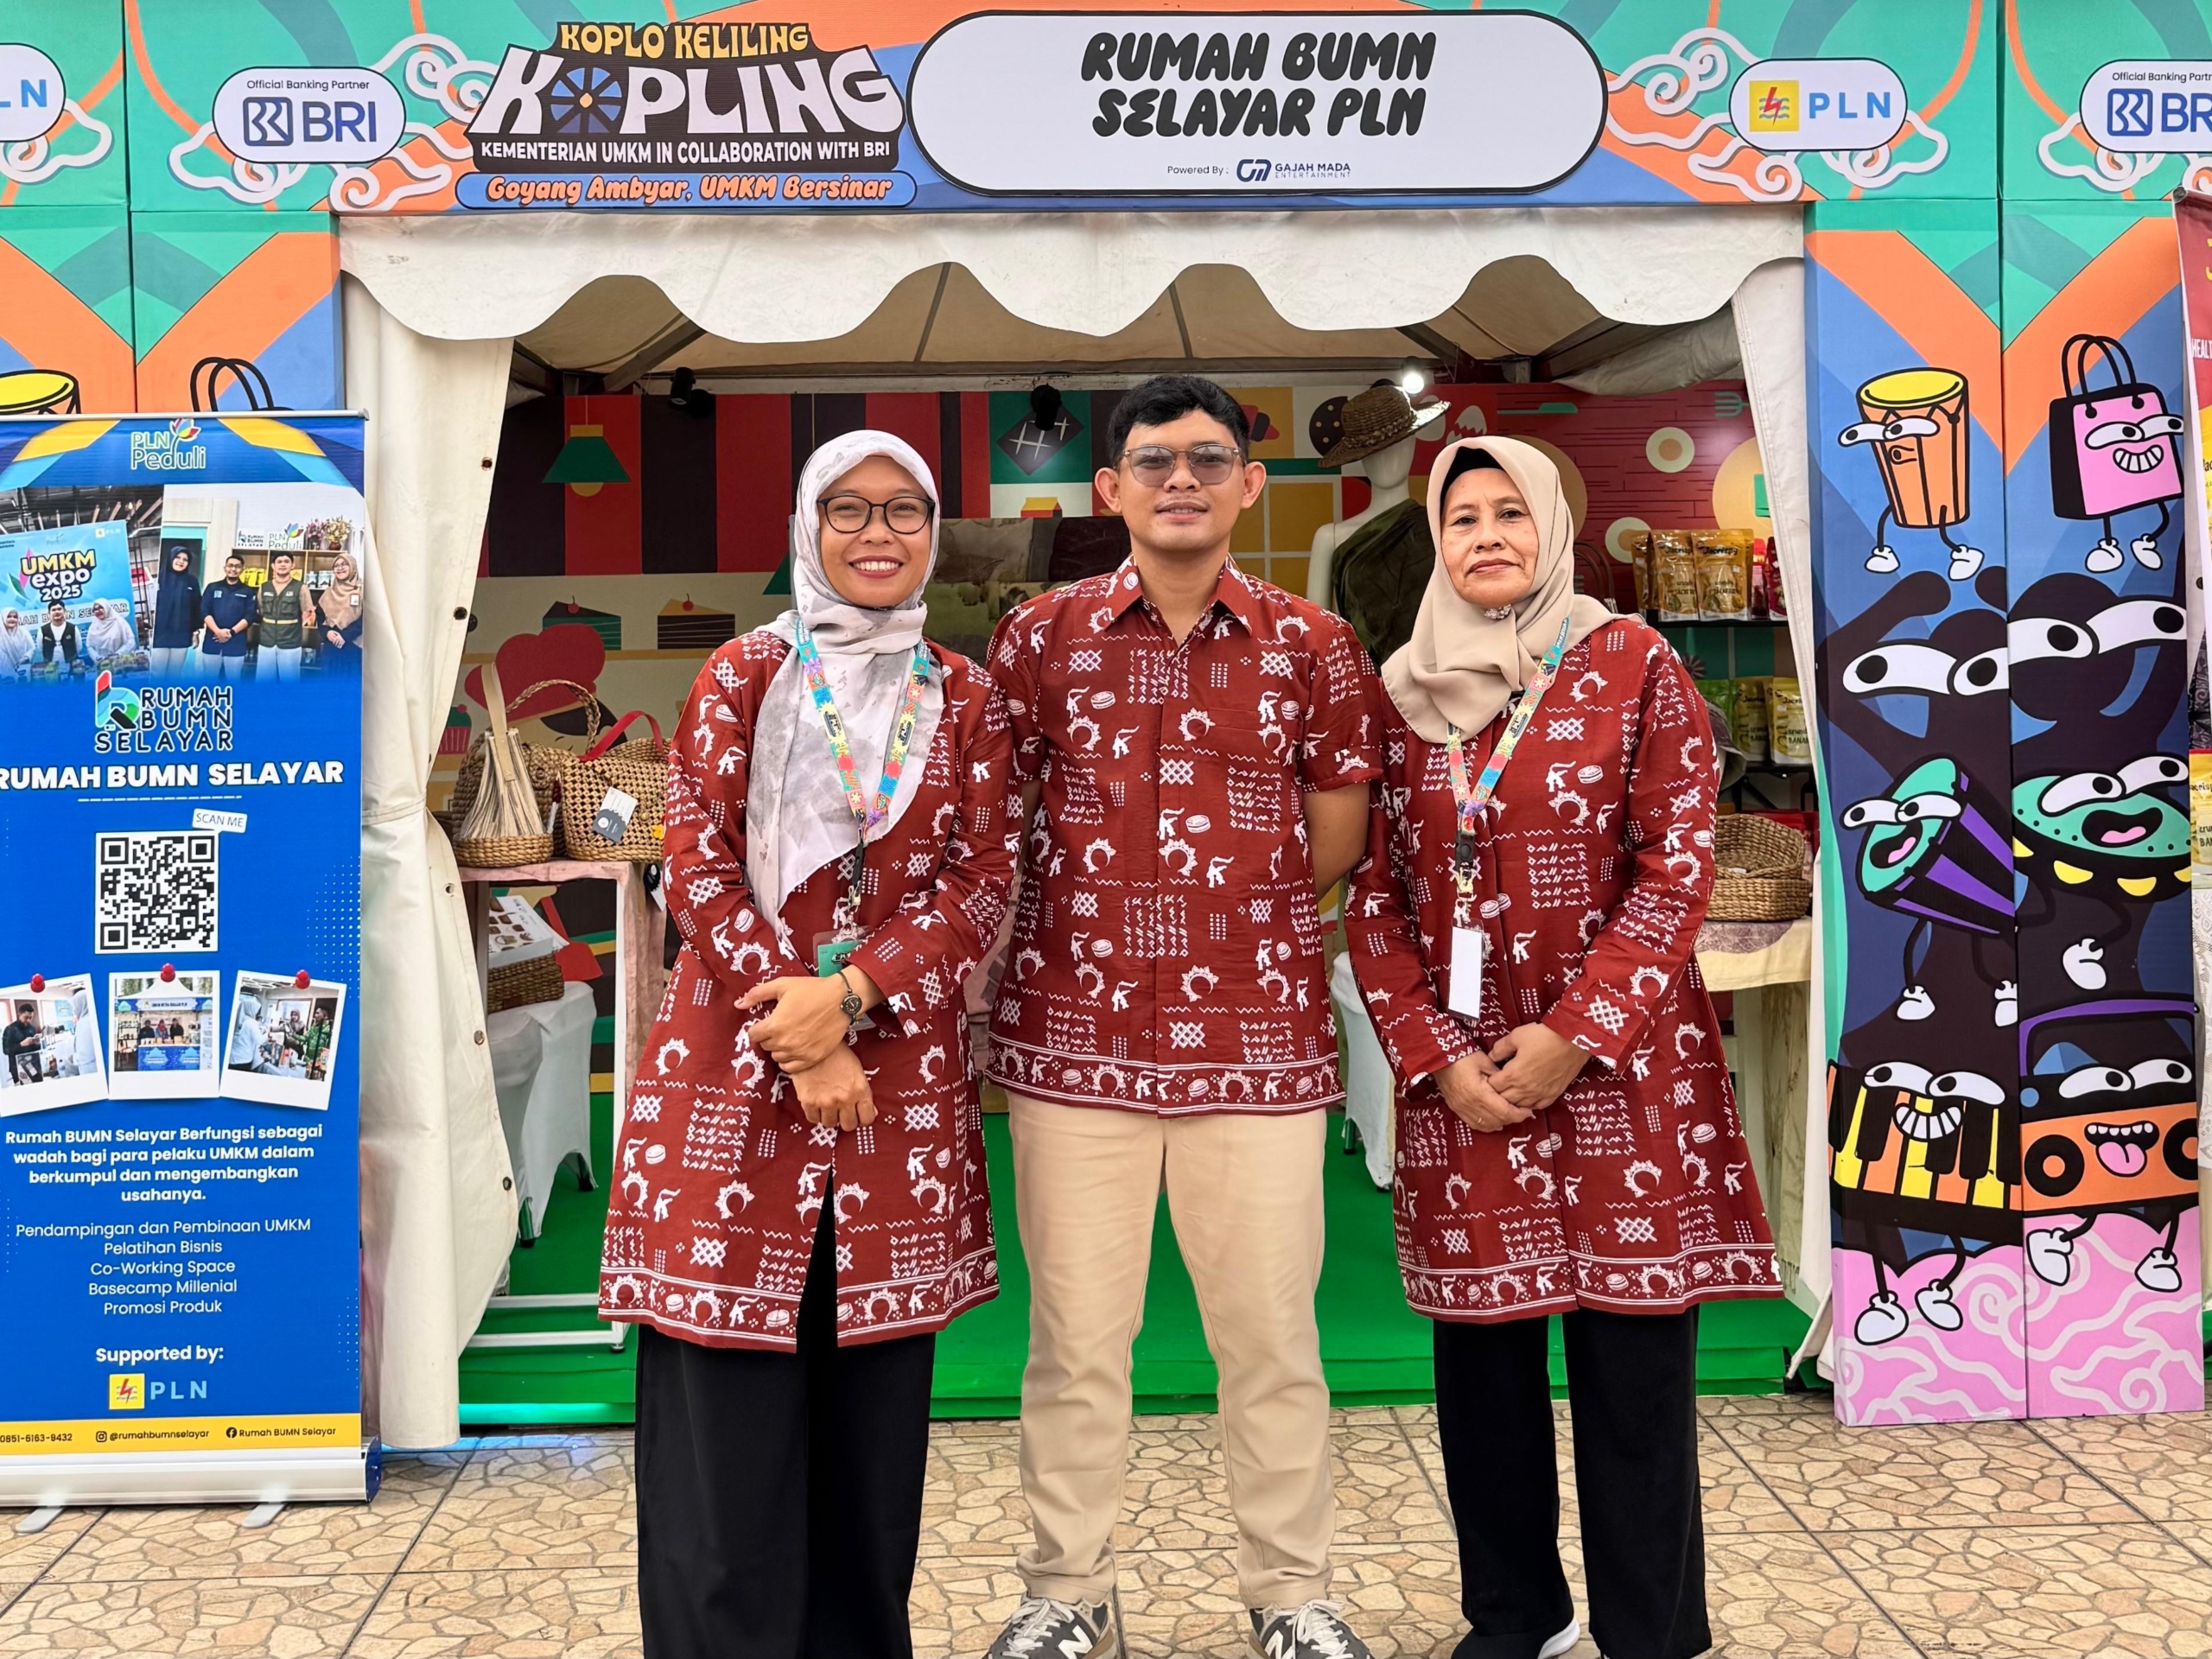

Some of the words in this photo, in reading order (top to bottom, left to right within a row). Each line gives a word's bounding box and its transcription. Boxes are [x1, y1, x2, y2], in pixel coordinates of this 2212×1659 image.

[561, 23, 664, 59] KOPLO
[675, 23, 810, 59] KELILING
[1081, 32, 1270, 81] RUMAH
[1282, 32, 1436, 80] BUMN
[247, 79, 284, 90] Official
[286, 79, 329, 92] Banking
[332, 79, 370, 90] Partner
[2112, 72, 2146, 81] Official
[2148, 72, 2187, 84] Banking
[1092, 88, 1315, 137] SELAYAR
[1327, 88, 1426, 137] PLN
[1808, 91, 1891, 118] PLN
[2161, 92, 2212, 133] BR
[302, 99, 378, 143] BRI
[481, 140, 598, 163] KEMENTERIAN
[602, 142, 652, 163] UMKM
[656, 142, 673, 163] IN
[677, 142, 813, 164] COLLABORATION
[817, 142, 860, 161] WITH
[863, 141, 891, 158] BRI
[1167, 166, 1211, 175] Powered
[1212, 166, 1224, 176] By
[1274, 162, 1314, 172] GAJAH
[1317, 162, 1351, 172] MADA
[486, 176, 580, 206] Goyang
[588, 176, 694, 204] Ambyar,
[700, 175, 778, 200] UMKM
[782, 176, 893, 201] Bersinar
[2190, 338, 2212, 359] HEALT
[130, 430, 170, 450] PLN
[130, 445, 207, 470] Peduli
[269, 539, 302, 550] Peduli
[21, 549, 97, 575] UMKM
[31, 568, 92, 588] expo
[41, 584, 82, 601] 2025
[140, 685, 233, 710] RUMAH
[140, 707, 233, 731] BUMN
[94, 728, 234, 753] SELAYAR
[0, 766, 101, 790] RUMAH
[106, 764, 199, 789] BUMN
[207, 760, 345, 785] SELAYAR
[196, 811, 226, 825] SCAN
[226, 816, 244, 828] ME
[6, 1129, 62, 1144] Rumah
[65, 1129, 112, 1144] BUMN
[115, 1128, 177, 1146] Selayar
[179, 1125, 255, 1145] Berfungsi
[257, 1123, 323, 1144] sebagai
[13, 1149, 67, 1164] wadah
[70, 1148, 107, 1167] bagi
[110, 1150, 149, 1166] para
[151, 1147, 207, 1166] pelaku
[209, 1146, 258, 1160] UMKM
[261, 1144, 315, 1159] dalam
[29, 1168, 117, 1186] berkumpul
[119, 1167, 151, 1181] dan
[154, 1165, 299, 1185] mengembangkan
[120, 1187, 207, 1205] usahanya.
[16, 1222, 135, 1239] Pendampingan
[138, 1221, 169, 1235] dan
[173, 1219, 261, 1235] Pembinaan
[264, 1218, 311, 1232] UMKM
[104, 1241, 176, 1255] Pelatihan
[180, 1239, 223, 1254] Bisnis
[90, 1261, 183, 1278] Co-Working
[187, 1260, 236, 1276] Space
[88, 1281, 172, 1297] Basecamp
[175, 1279, 238, 1294] Millenial
[104, 1300, 166, 1315] Promosi
[169, 1299, 223, 1313] Produk
[95, 1345, 192, 1366] Supported
[195, 1344, 225, 1365] by:
[149, 1380, 207, 1401] PLN
[109, 1428, 210, 1441] @rumahbumnselayar
[238, 1428, 272, 1438] Rumah
[274, 1427, 301, 1437] BUMN
[302, 1426, 337, 1439] Selayar
